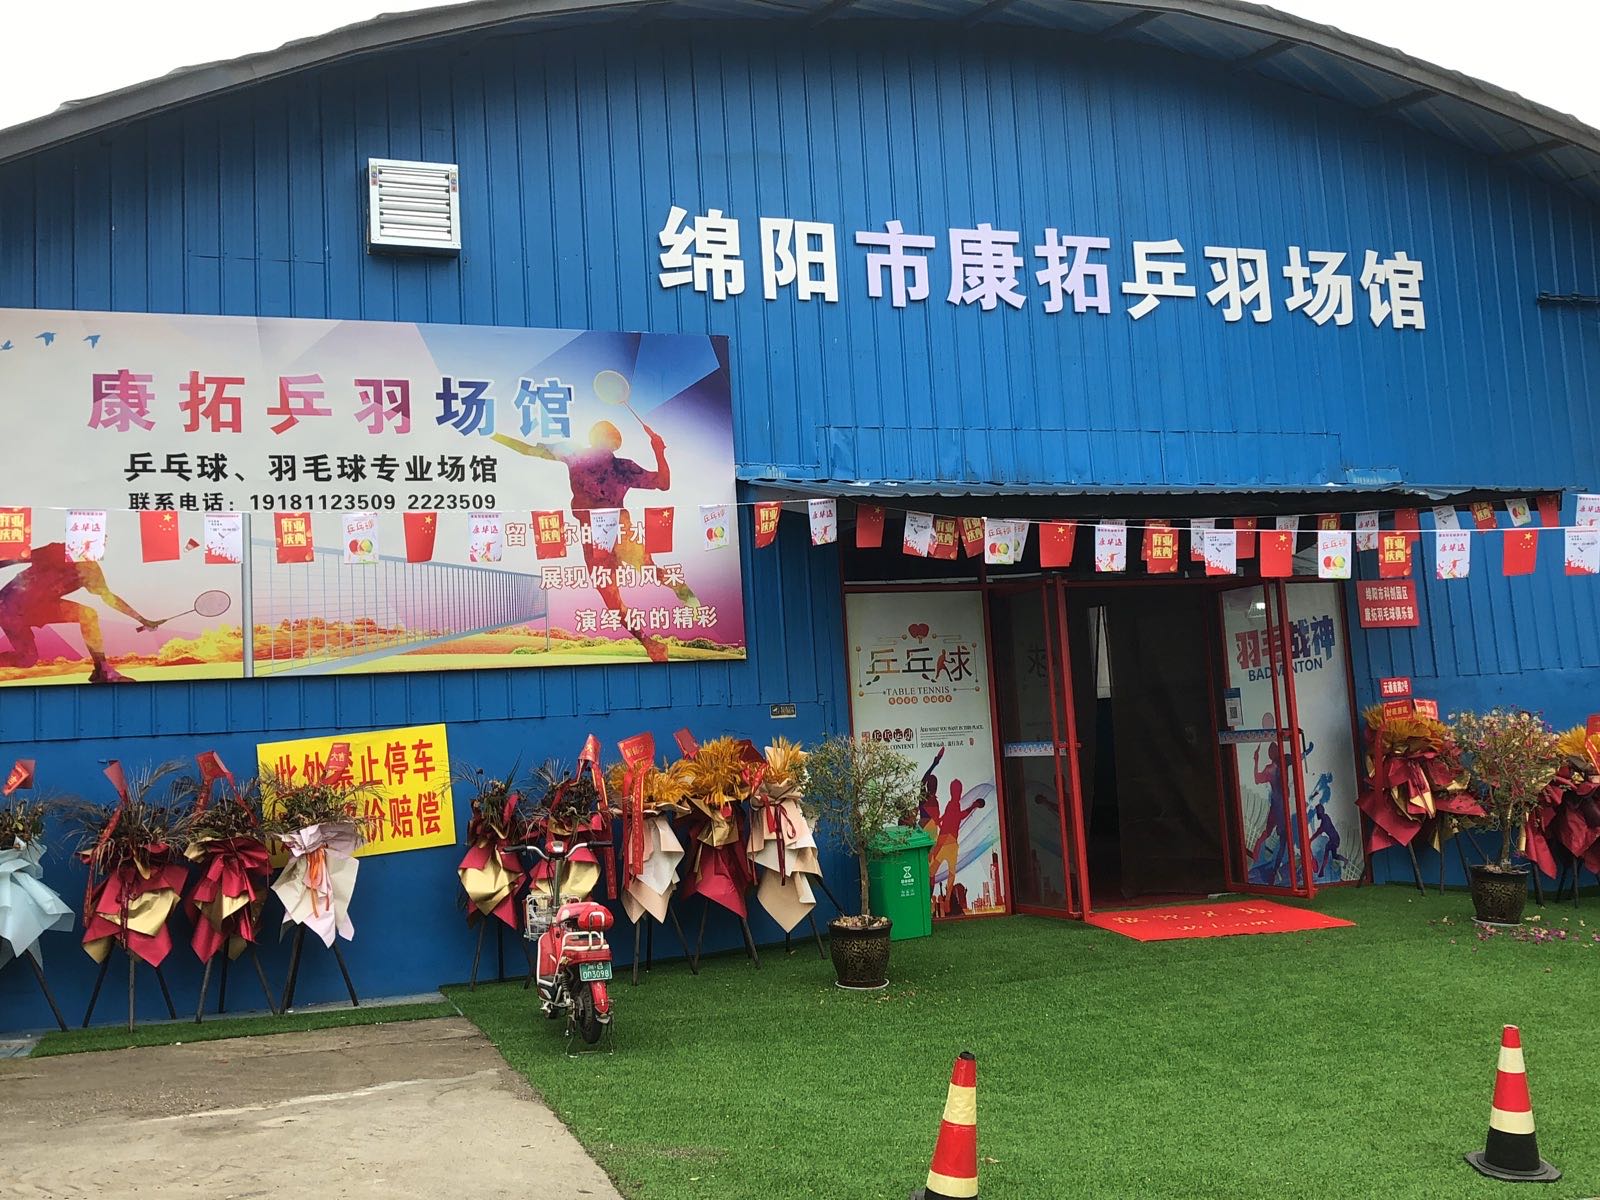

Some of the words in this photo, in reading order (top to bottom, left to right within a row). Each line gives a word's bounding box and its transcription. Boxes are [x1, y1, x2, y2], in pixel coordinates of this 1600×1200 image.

[658, 204, 1426, 330] 绵阳市康拓乒羽场馆
[88, 368, 575, 438] 康拓乒羽场馆
[124, 452, 498, 484] 乒乓球、羽毛球专业场馆
[408, 493, 497, 510] 2223509
[540, 563, 685, 590] 展现你的风采
[575, 606, 718, 632] 演绎你的精彩
[866, 645, 972, 687] 乒乓球
[886, 687, 915, 697] TABLE
[917, 686, 950, 695] TENNIS
